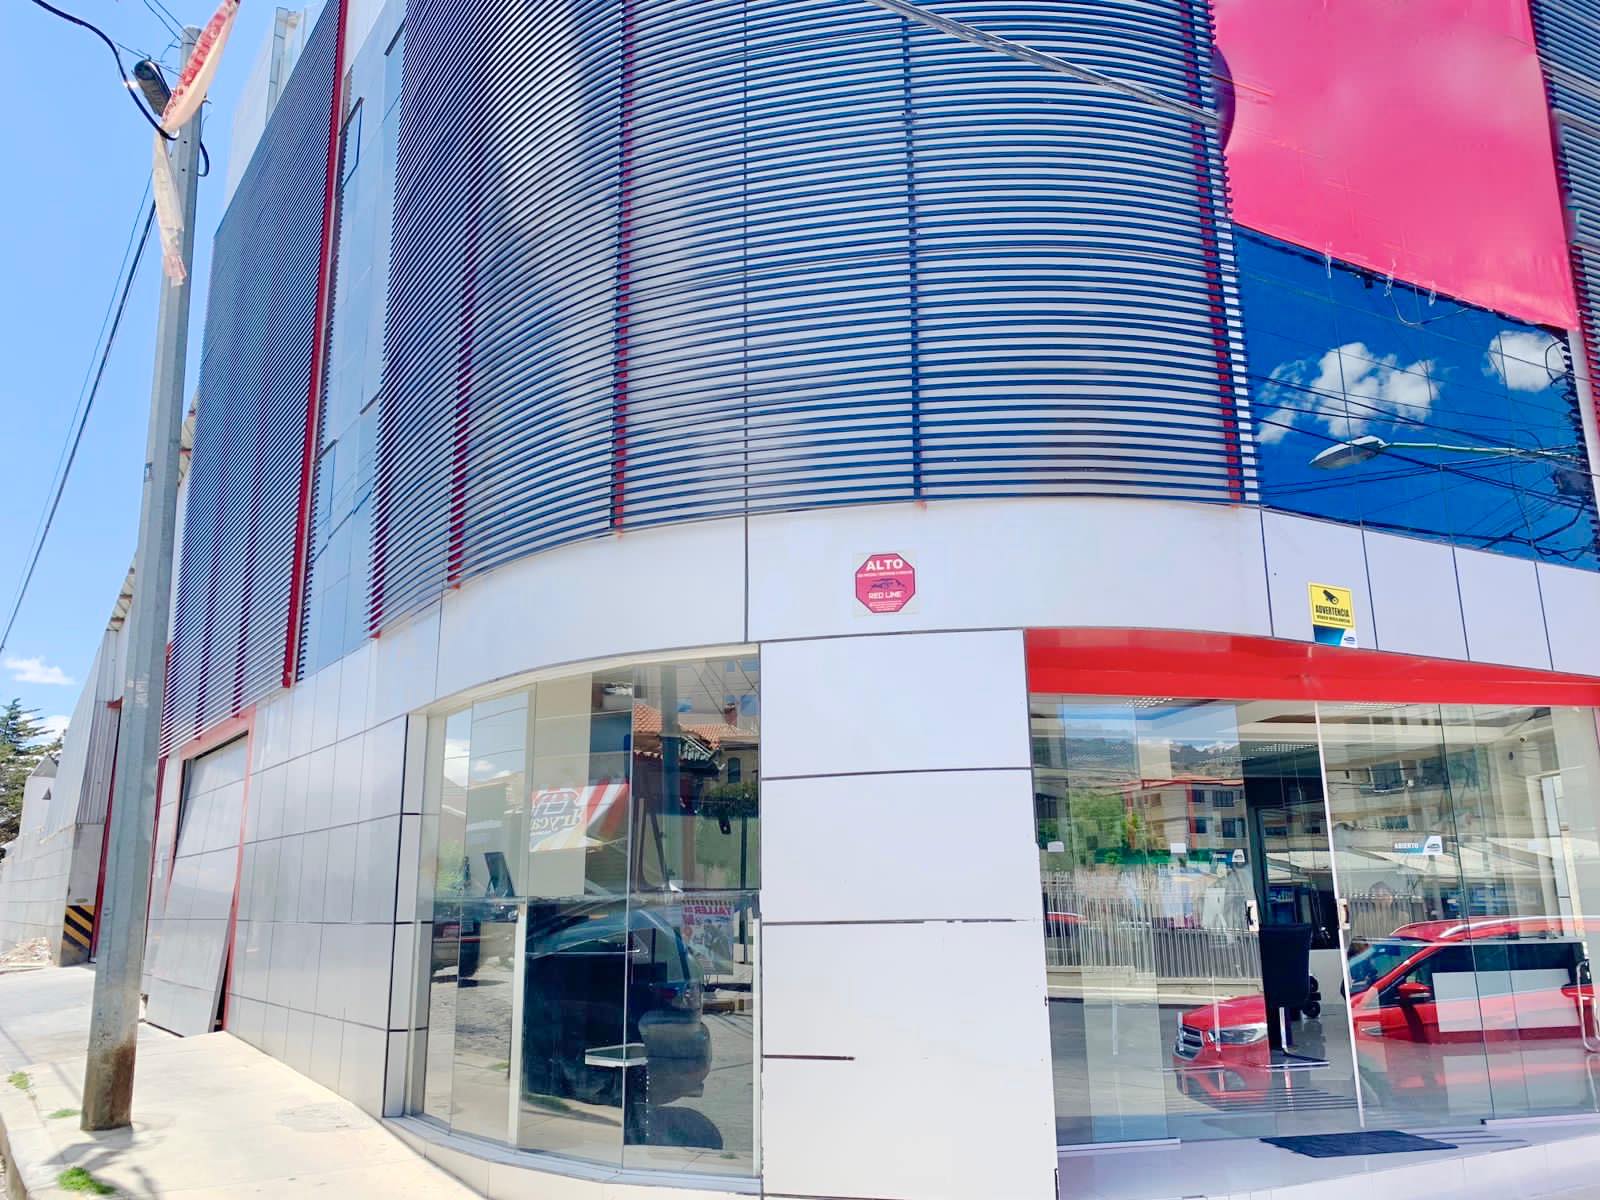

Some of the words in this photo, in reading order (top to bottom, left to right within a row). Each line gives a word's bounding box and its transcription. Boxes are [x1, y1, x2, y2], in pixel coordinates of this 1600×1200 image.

[865, 558, 904, 571] ALTO
[868, 591, 884, 600] RED
[885, 590, 903, 599] LINE
[1315, 604, 1350, 617] ADVERTENCIA
